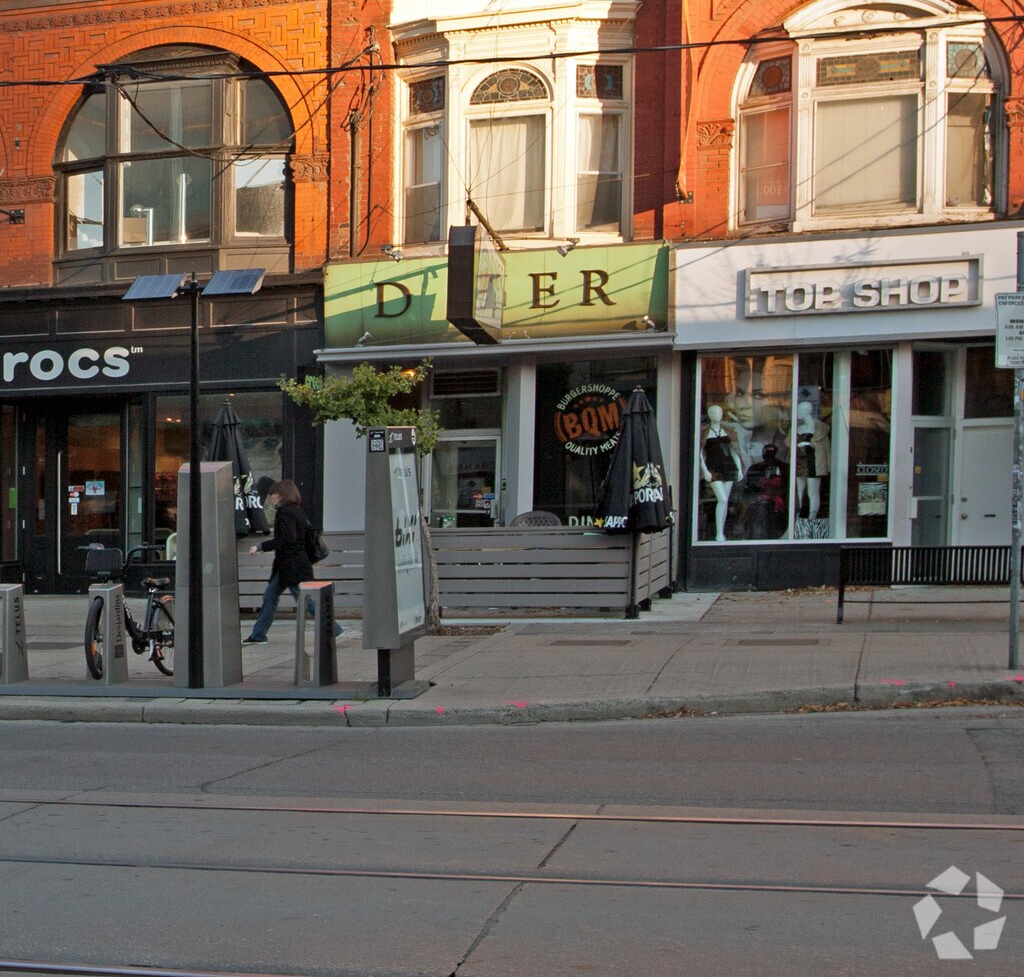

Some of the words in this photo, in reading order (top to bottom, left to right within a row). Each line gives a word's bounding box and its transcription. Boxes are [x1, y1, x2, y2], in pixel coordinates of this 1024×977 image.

[375, 270, 617, 318] DER
[761, 281, 842, 313] TOP
[853, 274, 968, 308] SHOP
[557, 384, 620, 411] BURGERSHOPPE
[565, 441, 598, 456] QUALITY
[13, 596, 21, 634] TELUS
[114, 593, 123, 643] Desjardins
